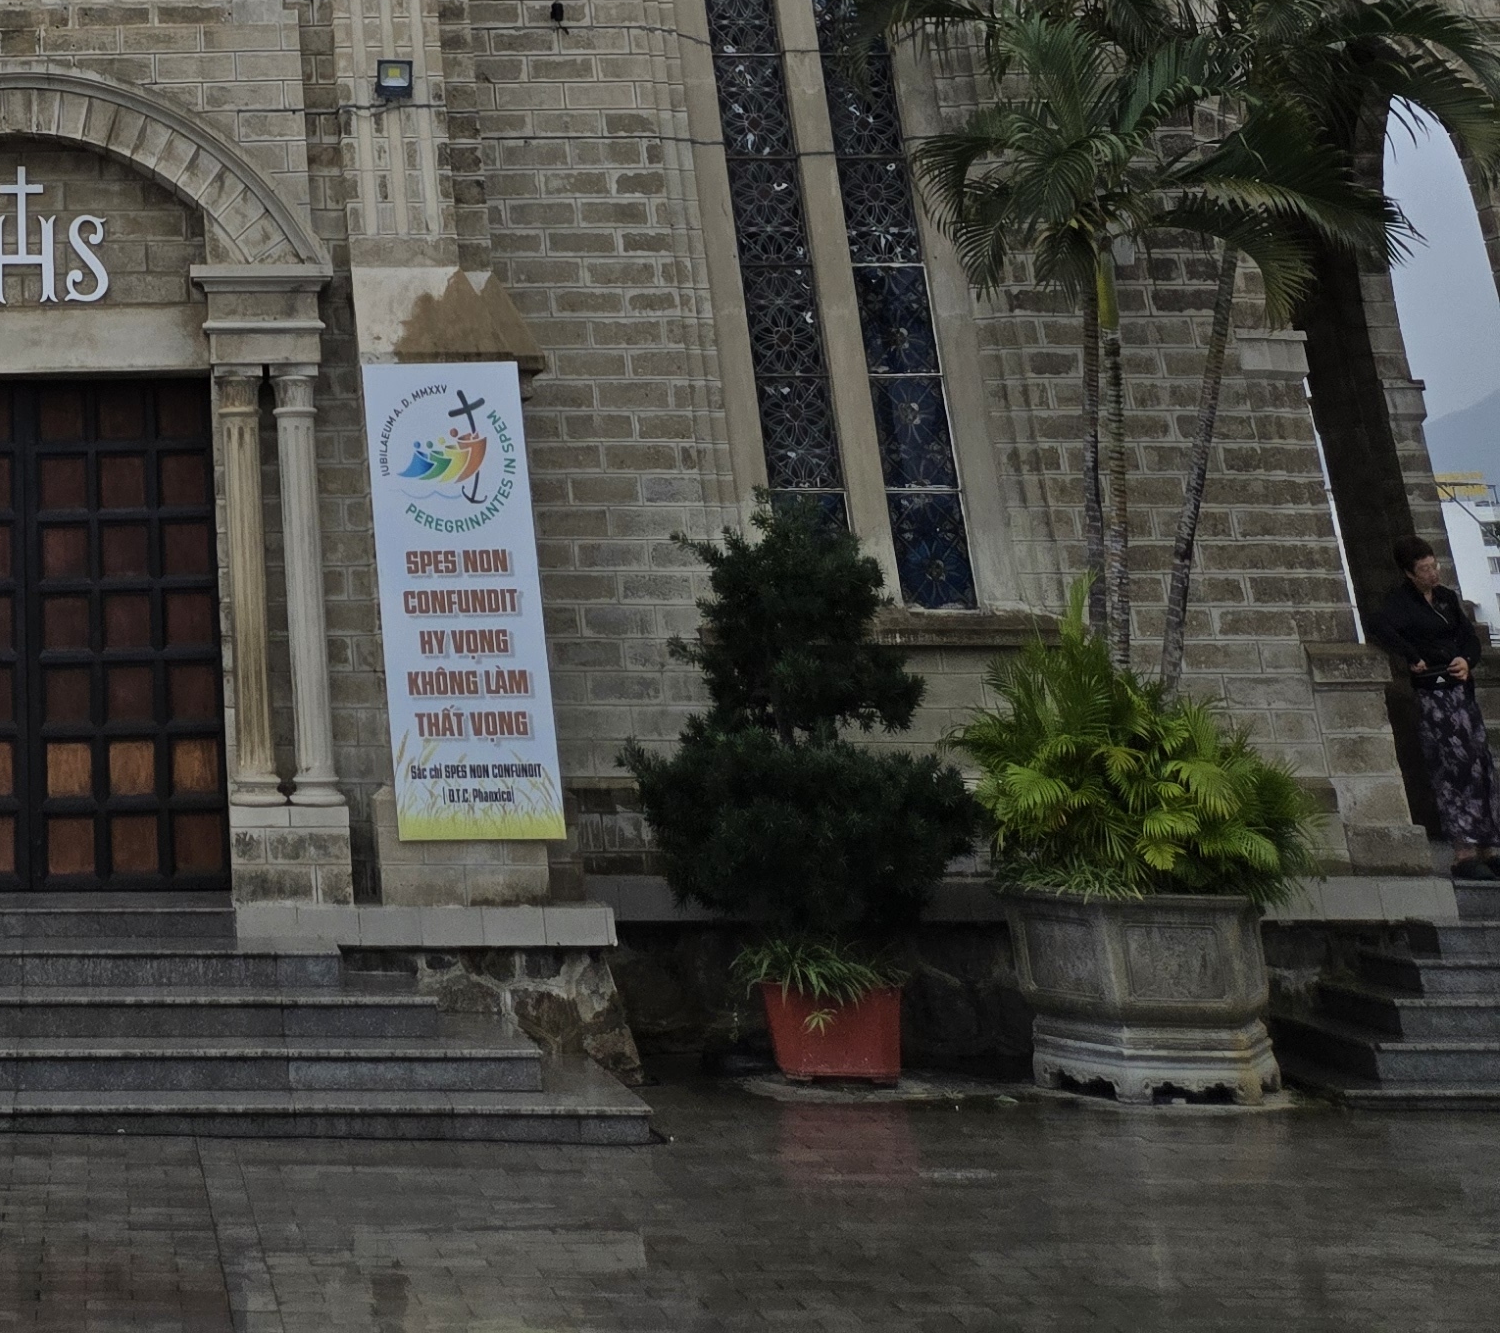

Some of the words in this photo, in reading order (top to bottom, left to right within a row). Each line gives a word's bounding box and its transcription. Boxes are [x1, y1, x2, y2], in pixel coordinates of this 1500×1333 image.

[379, 415, 397, 477] IUBILAEUM
[411, 384, 448, 402] MMXXV
[486, 409, 515, 453] SPEM
[503, 457, 517, 475] IN
[405, 478, 514, 534] PEREGRINANTES
[405, 550, 458, 575] SPES
[462, 549, 509, 573] NON
[403, 588, 518, 615] CONFUNDIT
[419, 630, 446, 654] HY
[450, 629, 509, 660] VỌNG
[407, 666, 479, 696] KHÔNG
[484, 665, 529, 695] LÀM
[415, 704, 465, 738] THẤT
[469, 711, 529, 743] VỌNG
[444, 764, 467, 779] SPES
[469, 764, 489, 779] NON
[491, 763, 542, 779] CONFUNDIT
